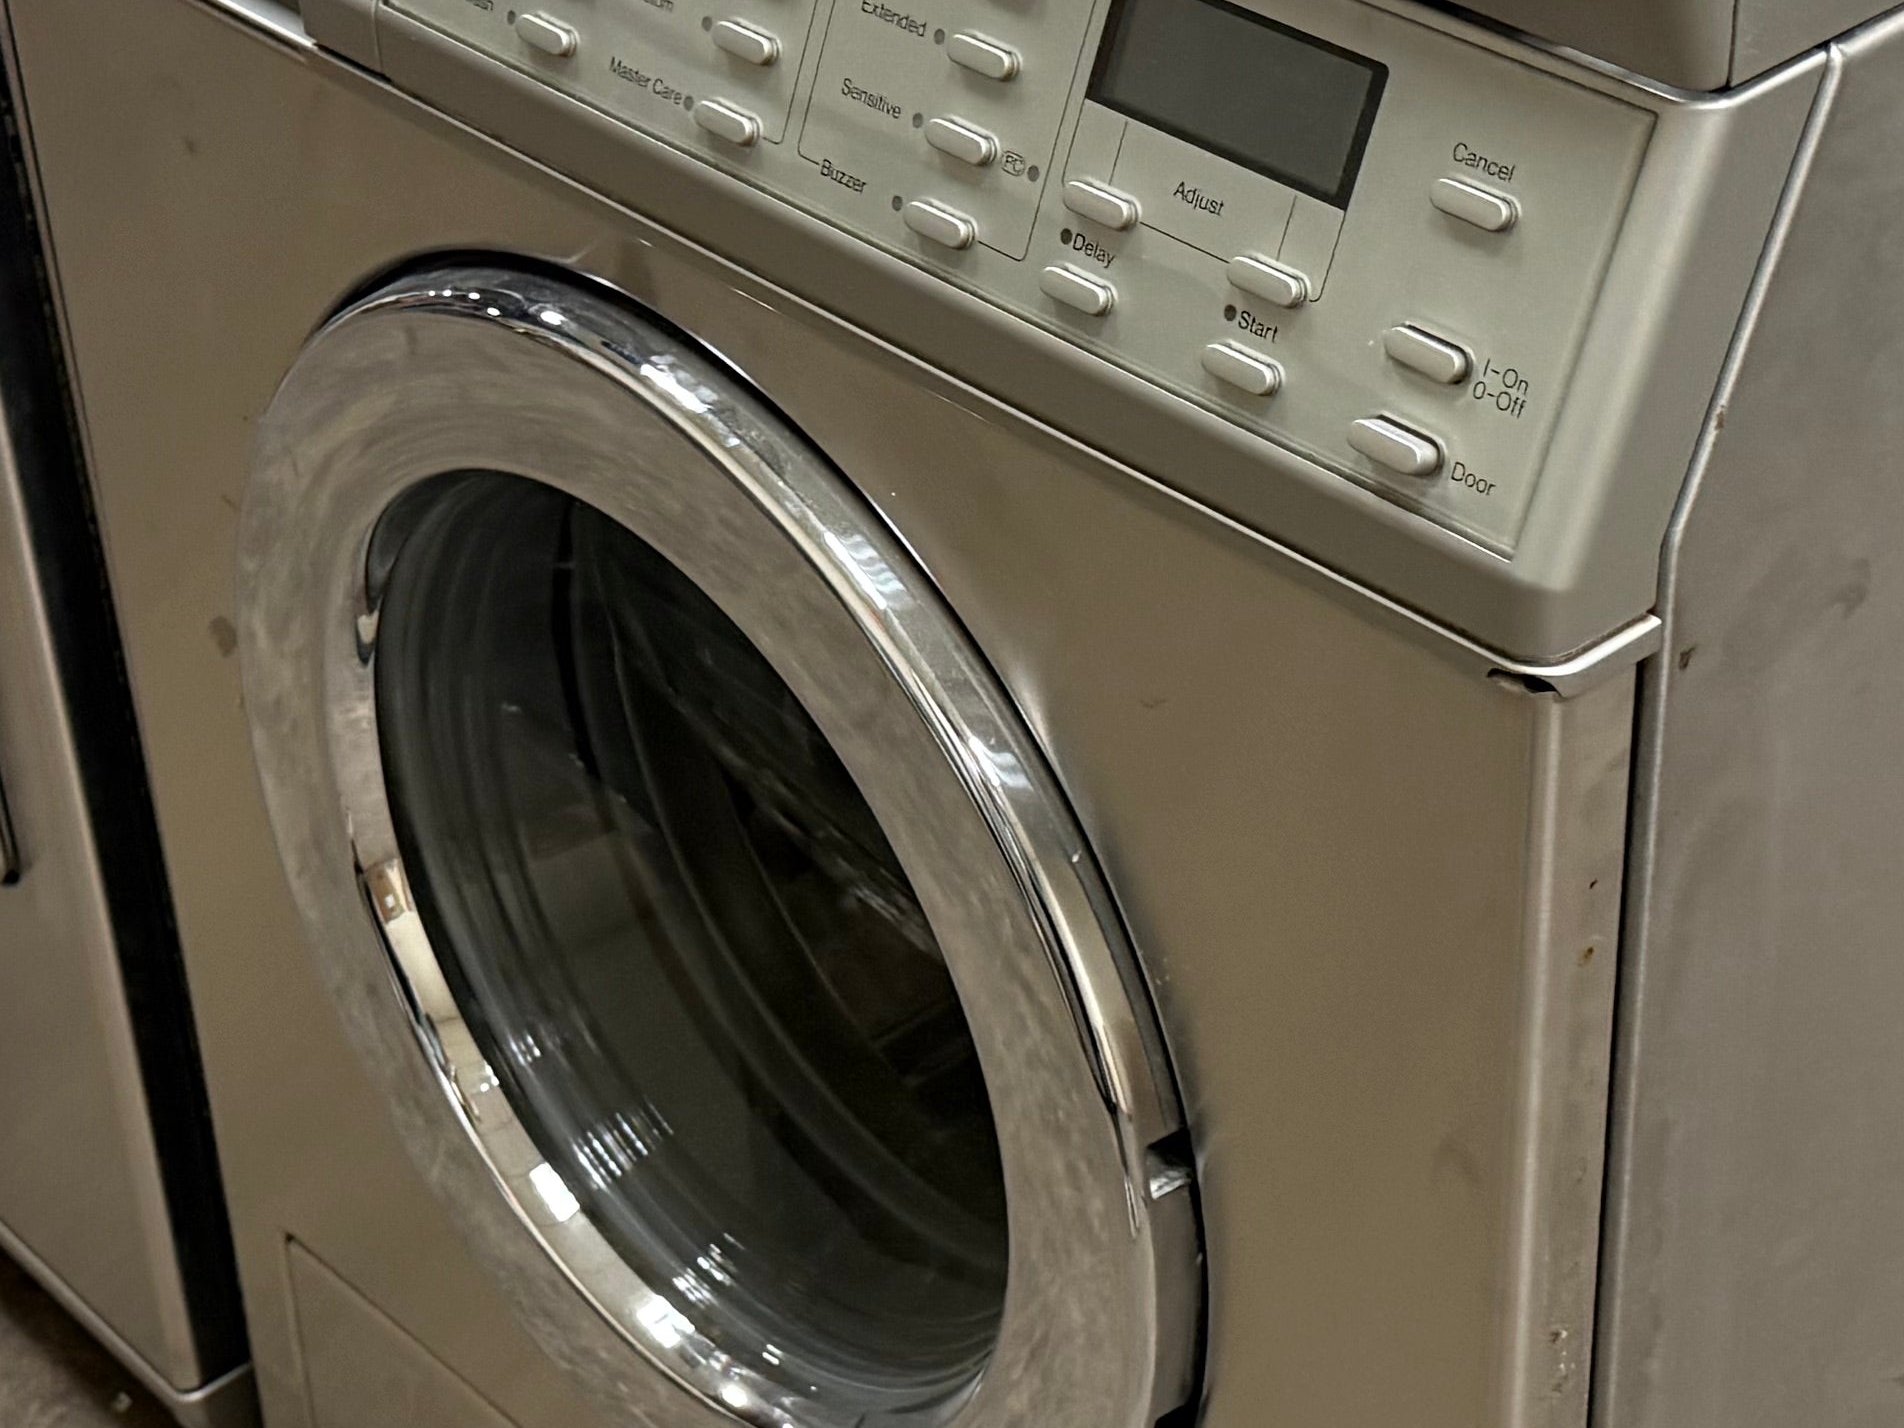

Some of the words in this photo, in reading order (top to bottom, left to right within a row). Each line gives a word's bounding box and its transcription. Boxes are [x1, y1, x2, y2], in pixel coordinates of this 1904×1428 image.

[610, 56, 651, 90] Master
[653, 77, 683, 105] Care
[841, 78, 902, 119] Sensitive
[819, 159, 867, 193] Buzzer
[1453, 142, 1516, 181] Cancel
[1173, 180, 1224, 216] Adjust
[1073, 233, 1116, 269] Delay
[1237, 309, 1279, 343] Start
[1451, 461, 1496, 497] Door
